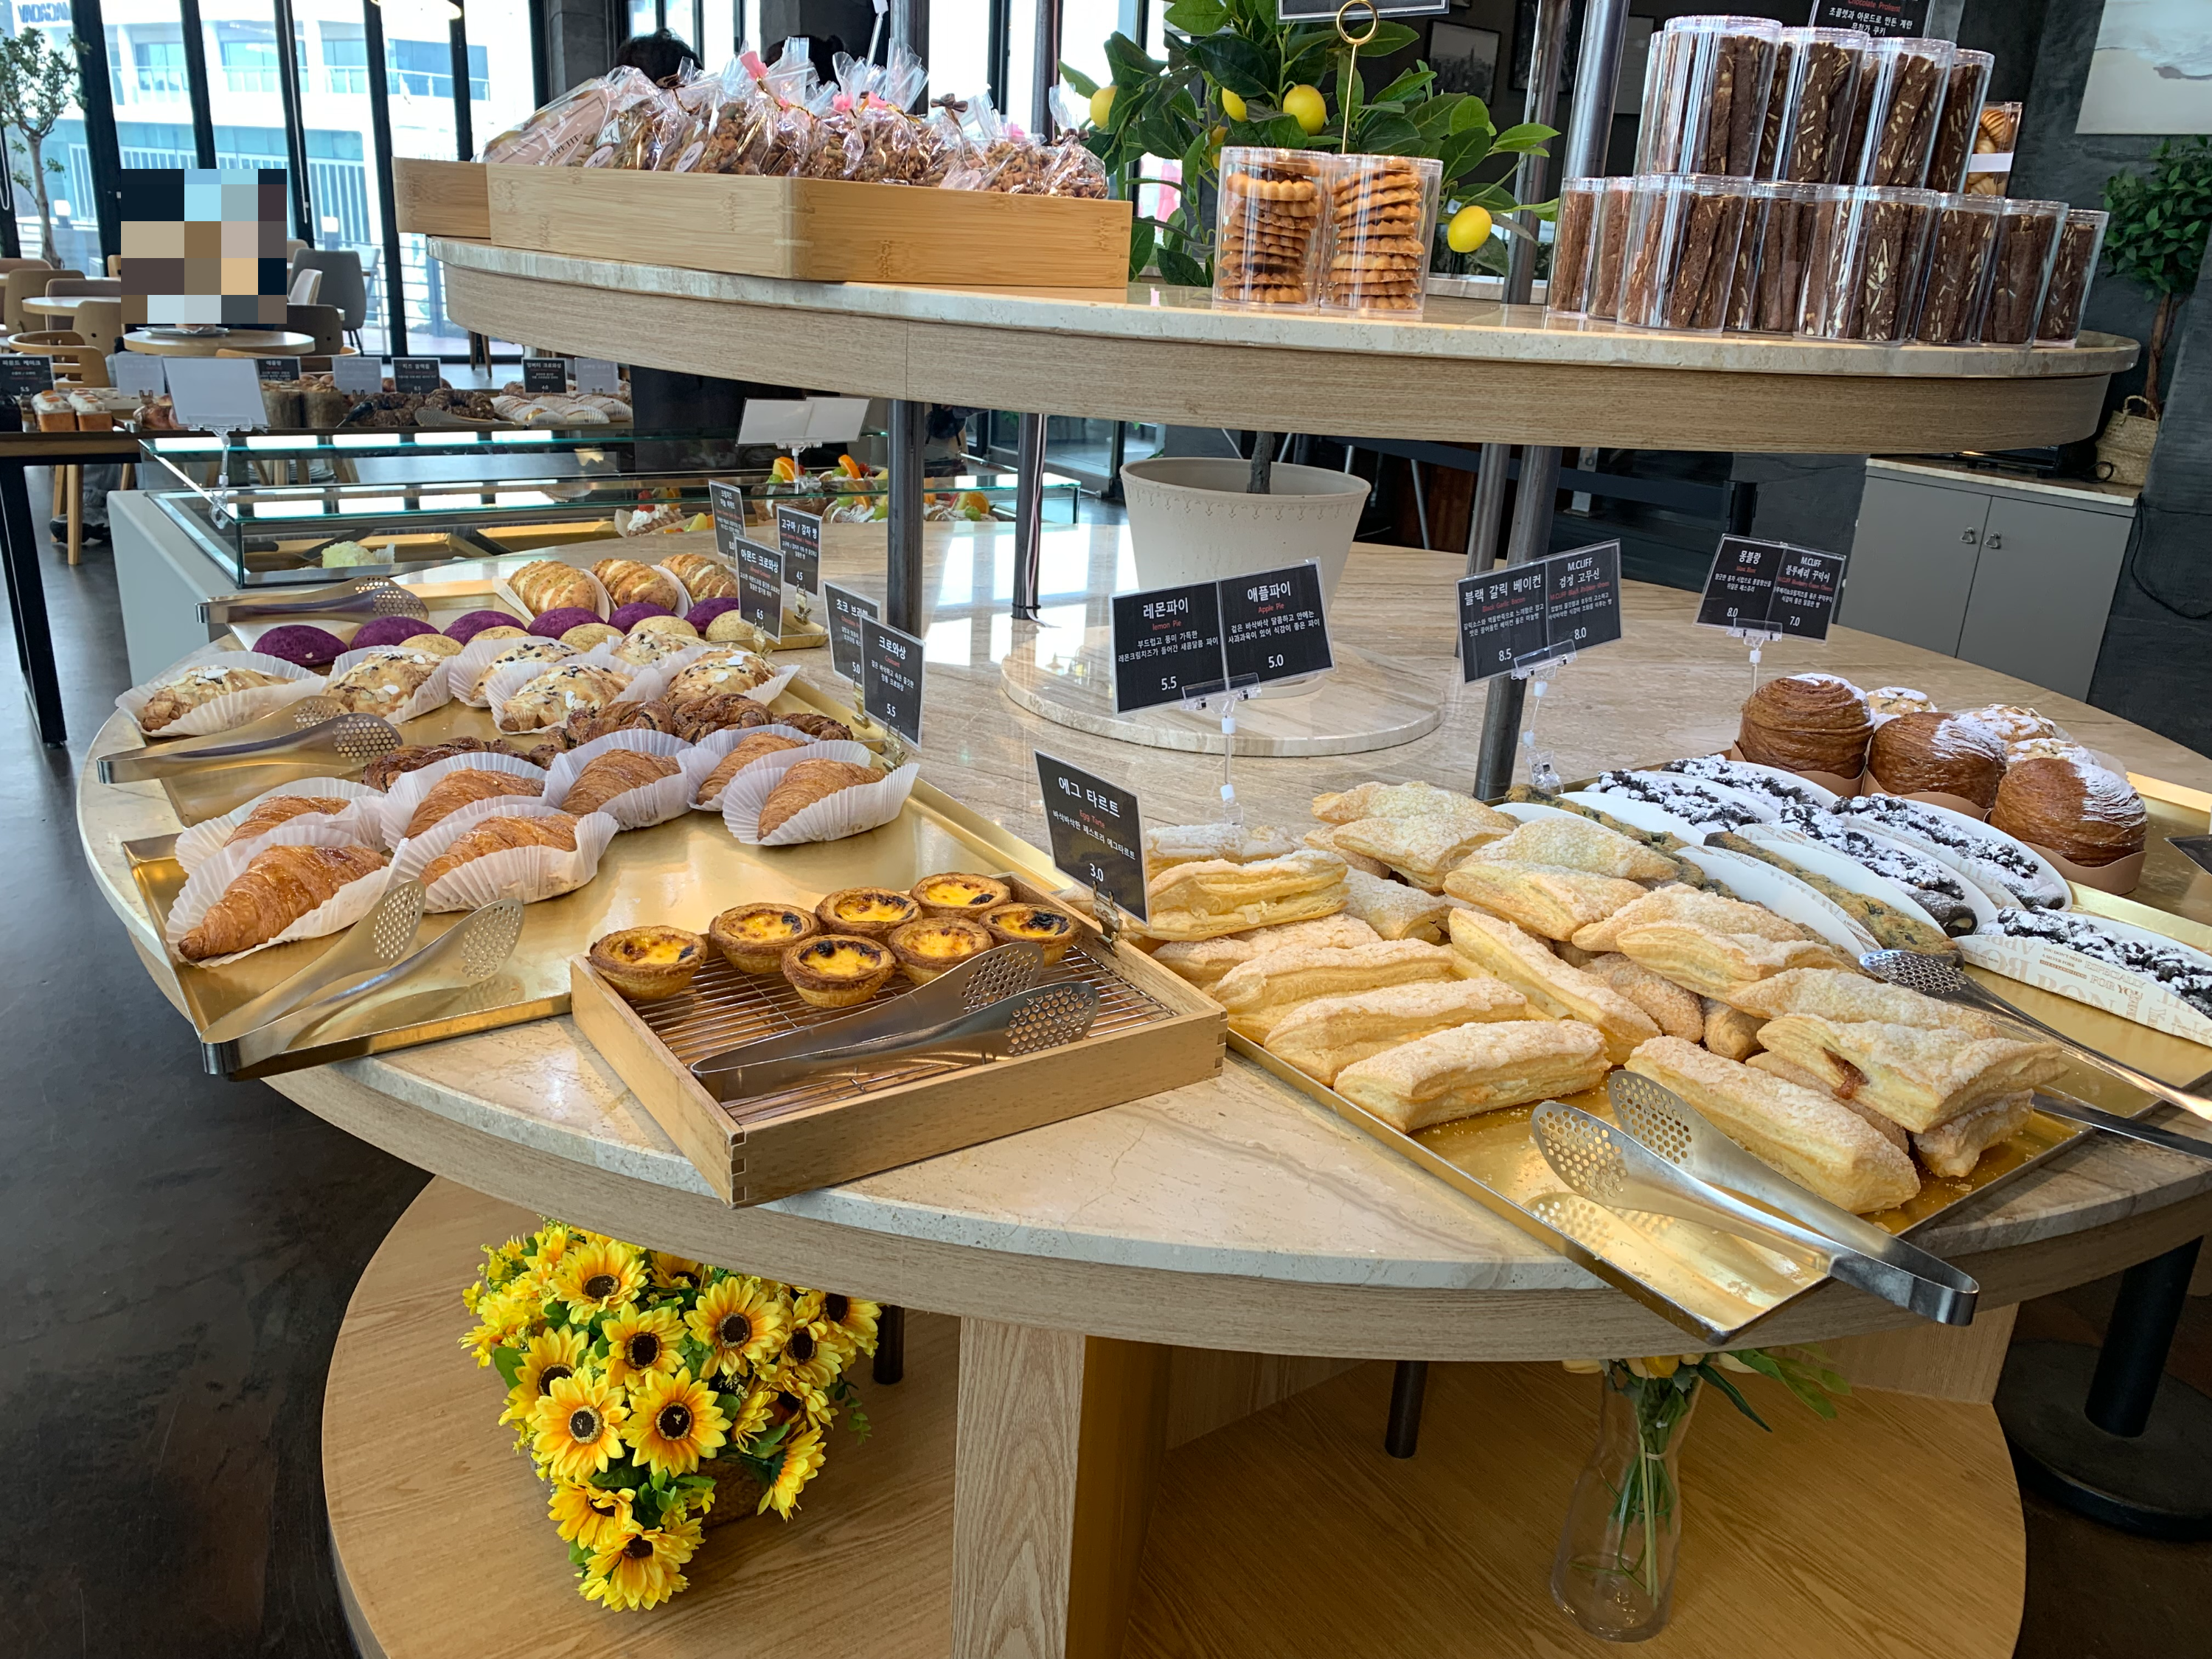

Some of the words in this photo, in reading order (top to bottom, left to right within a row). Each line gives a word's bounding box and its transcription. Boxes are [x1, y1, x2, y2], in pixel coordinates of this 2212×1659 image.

[1857, 12, 1882, 24] 아몬드로
[1885, 17, 1897, 27] 만든
[1900, 19, 1913, 29] 계란
[1873, 27, 1886, 36] 쿠키
[782, 518, 796, 532] 고구마
[801, 524, 810, 537] 감자
[813, 527, 817, 539] 빵
[741, 549, 757, 563] 아몬드
[759, 555, 779, 574] 크로와상
[1568, 557, 1593, 571] M.CLIFF
[1739, 550, 1761, 565] 몽블랑
[1801, 556, 1822, 568] M.CLIFF
[1559, 574, 1573, 588] 검정
[1578, 568, 1599, 582] 고무신
[1786, 565, 1810, 579] 블루베리
[1812, 570, 1830, 583] 꾸덕이
[1247, 581, 1291, 602] 애플파이
[1464, 588, 1484, 606] 블랙
[1489, 582, 1508, 599] 갈릭
[1513, 574, 1541, 593] 베이컨
[836, 598, 849, 613] 초코
[1143, 597, 1189, 619] 레몬파이
[1258, 605, 1274, 614] Apple
[1276, 602, 1284, 611] Pie
[1727, 607, 1739, 618] 8.0
[1231, 624, 1242, 634] 겉은
[1245, 619, 1268, 630] 바삭바삭
[1270, 614, 1294, 626] 달콤하고
[1296, 611, 1315, 620] 안에는
[1464, 619, 1486, 630] 갈릭소스와
[1487, 611, 1514, 623] 먹물반죽으로
[1535, 603, 1544, 611] 잡고
[1500, 619, 1514, 628] 베이컨
[1526, 613, 1540, 621] 마늘빵
[1790, 616, 1801, 626] 7.0
[1138, 637, 1162, 649] 부드럽고
[1165, 634, 1177, 644] 풍미
[1180, 630, 1197, 641] 가득한
[1228, 631, 1257, 644] 사과과육이
[1259, 628, 1271, 638] 있어
[1273, 625, 1291, 634] 식감이
[1293, 622, 1305, 631] 좋은
[1308, 619, 1320, 627] 파이
[1574, 627, 1587, 640] 8.0
[879, 636, 906, 660] 크로와상
[1118, 647, 1158, 662] 레몬크림치즈가
[1161, 644, 1178, 655] 들어간
[1180, 639, 1203, 651] 새콤달콤
[1206, 636, 1218, 646] 파이
[1498, 648, 1512, 661] 8.5
[1268, 654, 1284, 668] 5.0
[872, 660, 878, 669] 겉은
[895, 672, 902, 682] 속은
[890, 679, 904, 692] 크로와상
[1161, 676, 1177, 691] 5.5
[886, 703, 896, 717] 5.5
[1058, 776, 1082, 798] 에그
[1086, 789, 1120, 818] 타르트
[1079, 809, 1090, 822] Egg
[1053, 810, 1081, 830] 바삭바삭한
[1082, 824, 1105, 844] 페스트리
[1107, 838, 1135, 860] 에그타르트
[1090, 863, 1104, 882] 3.0
[2046, 955, 2062, 964] SILVER
[2053, 950, 2069, 959] DON'T
[2070, 955, 2082, 963] NEED
[2084, 961, 2146, 989] ESPECIALLY
[2090, 974, 2115, 991] FOR
[2117, 984, 2143, 1001] YOU
